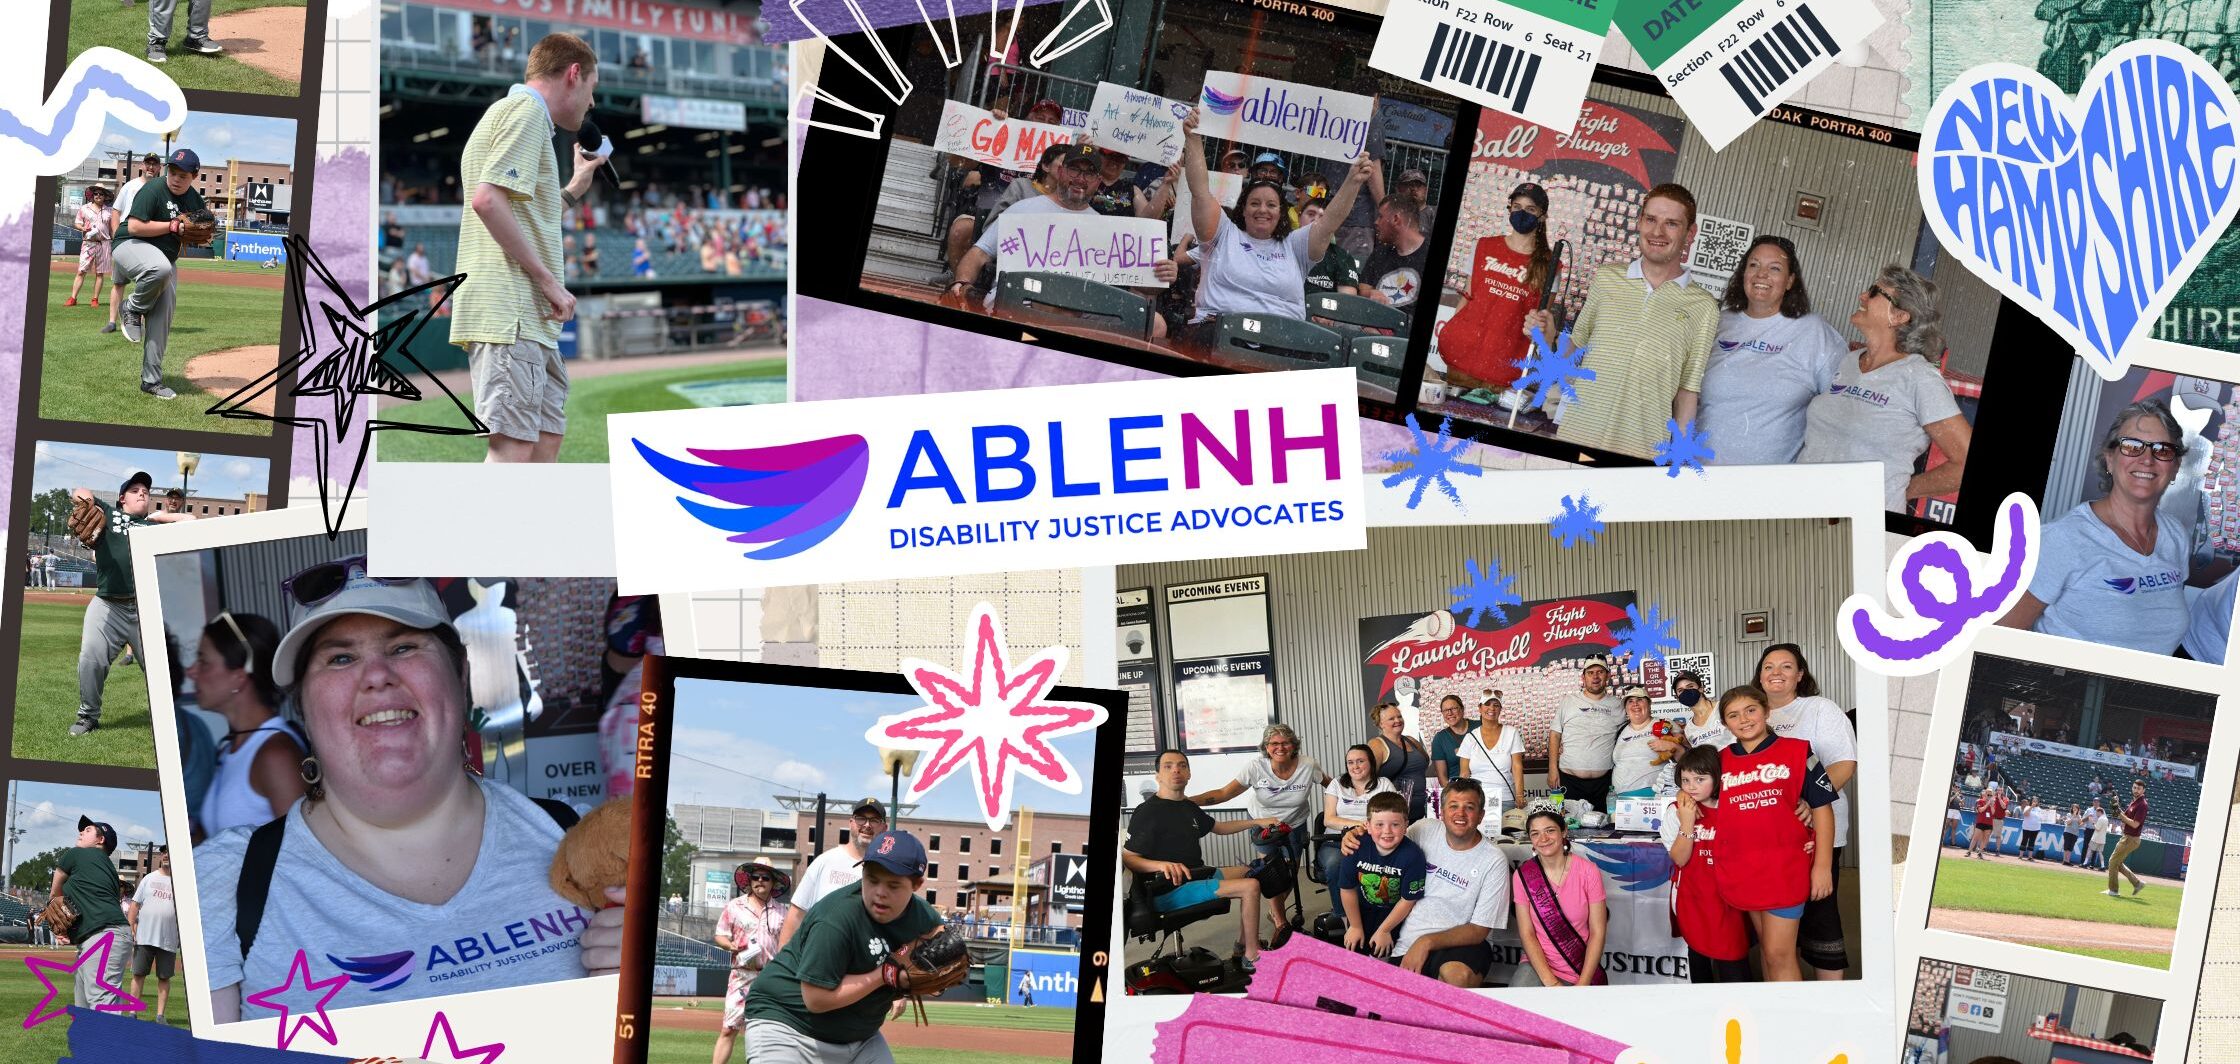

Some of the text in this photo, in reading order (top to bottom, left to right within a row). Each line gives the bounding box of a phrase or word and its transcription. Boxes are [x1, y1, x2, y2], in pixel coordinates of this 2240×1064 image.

[564, 0, 662, 26] FAMILY
[672, 8, 738, 34] FUN!
[1311, 9, 1335, 22] 400
[1455, 8, 1478, 24] F22
[1484, 12, 1514, 32] Row
[1525, 32, 1533, 42] 6
[1544, 33, 1574, 53] Seat
[1577, 49, 1592, 62] 21
[1667, 49, 1713, 88] Section
[1717, 33, 1740, 53] F22
[1737, 8, 1765, 34] Row
[1103, 102, 1120, 120] Art
[1242, 87, 1368, 160] ablenh.org
[1811, 116, 1865, 137] PORTRA
[1868, 127, 1892, 143] 400
[971, 118, 1008, 157] GO
[1471, 124, 1539, 159] Ball
[1555, 130, 1631, 157] Hunger
[1082, 146, 1092, 155] P
[238, 242, 282, 256] nthem
[1000, 224, 1163, 269] #WeAreABLE
[1484, 277, 1530, 298] FOUNDATION
[1488, 286, 1520, 301] 50/50
[2147, 307, 2240, 341] HIRE
[1845, 385, 1890, 405] ABLENH
[1172, 580, 1260, 599] UPCOMING EVENTS
[1545, 605, 1586, 626] Fight
[1543, 620, 1600, 642] Hunger
[1391, 631, 1479, 674] Launch
[1456, 631, 1532, 671] a Ball
[1132, 670, 1144, 679] UP
[1183, 661, 1262, 675] UPCOMING EVENTS
[641, 692, 657, 715] 40
[636, 722, 655, 779] RTRA
[545, 760, 596, 778] OVER
[1720, 762, 1791, 792] Fisher Cats
[567, 783, 601, 797] NEW
[1642, 807, 1656, 815] $15
[1738, 797, 1778, 811] 50/50
[877, 835, 896, 855] B
[2014, 826, 2083, 857] ANK
[1436, 867, 1470, 888] ABLENH
[706, 893, 727, 901] BARN
[426, 905, 589, 971] ABLENH
[429, 961, 493, 983] DISABILITY
[495, 949, 539, 967] JUSTICE
[619, 1014, 635, 1039] 51
